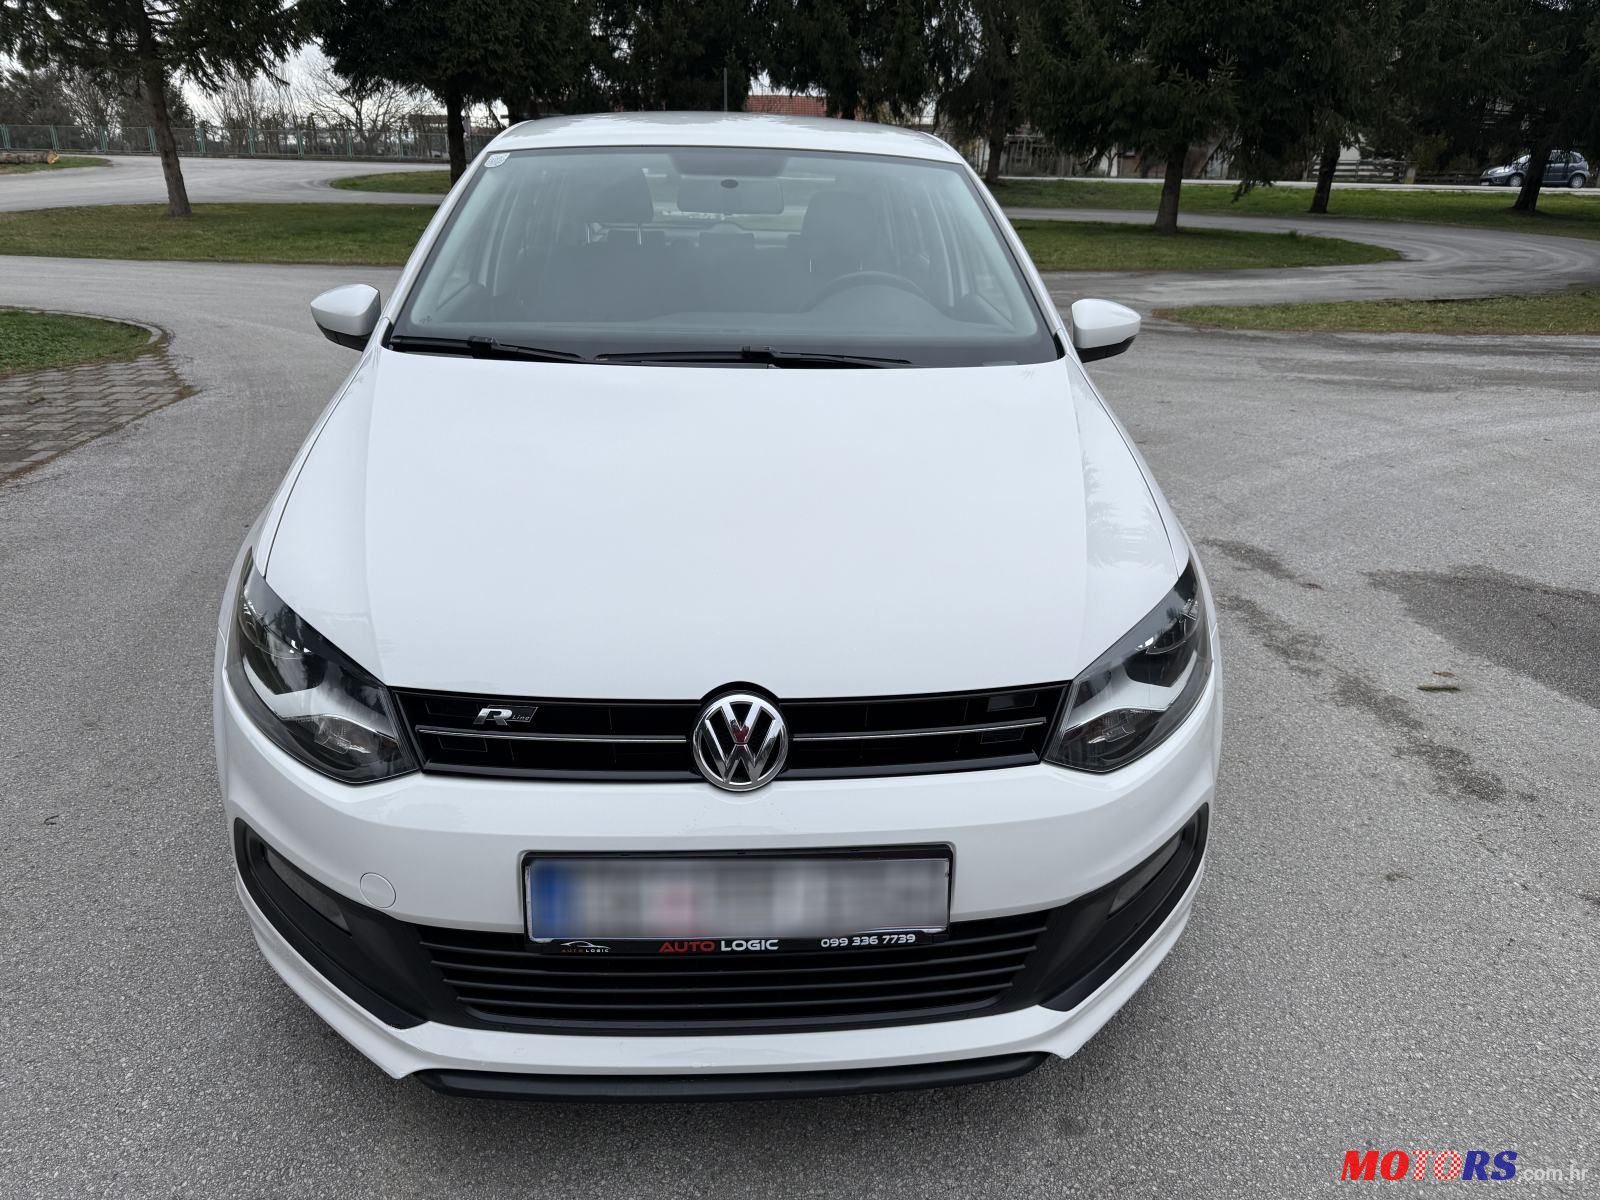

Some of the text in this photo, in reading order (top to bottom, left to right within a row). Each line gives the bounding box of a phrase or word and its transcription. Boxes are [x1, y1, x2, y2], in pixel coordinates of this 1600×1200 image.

[473, 708, 512, 725] R
[658, 939, 779, 954] AUTO LOGIC
[820, 933, 916, 948] 099 336 7739
